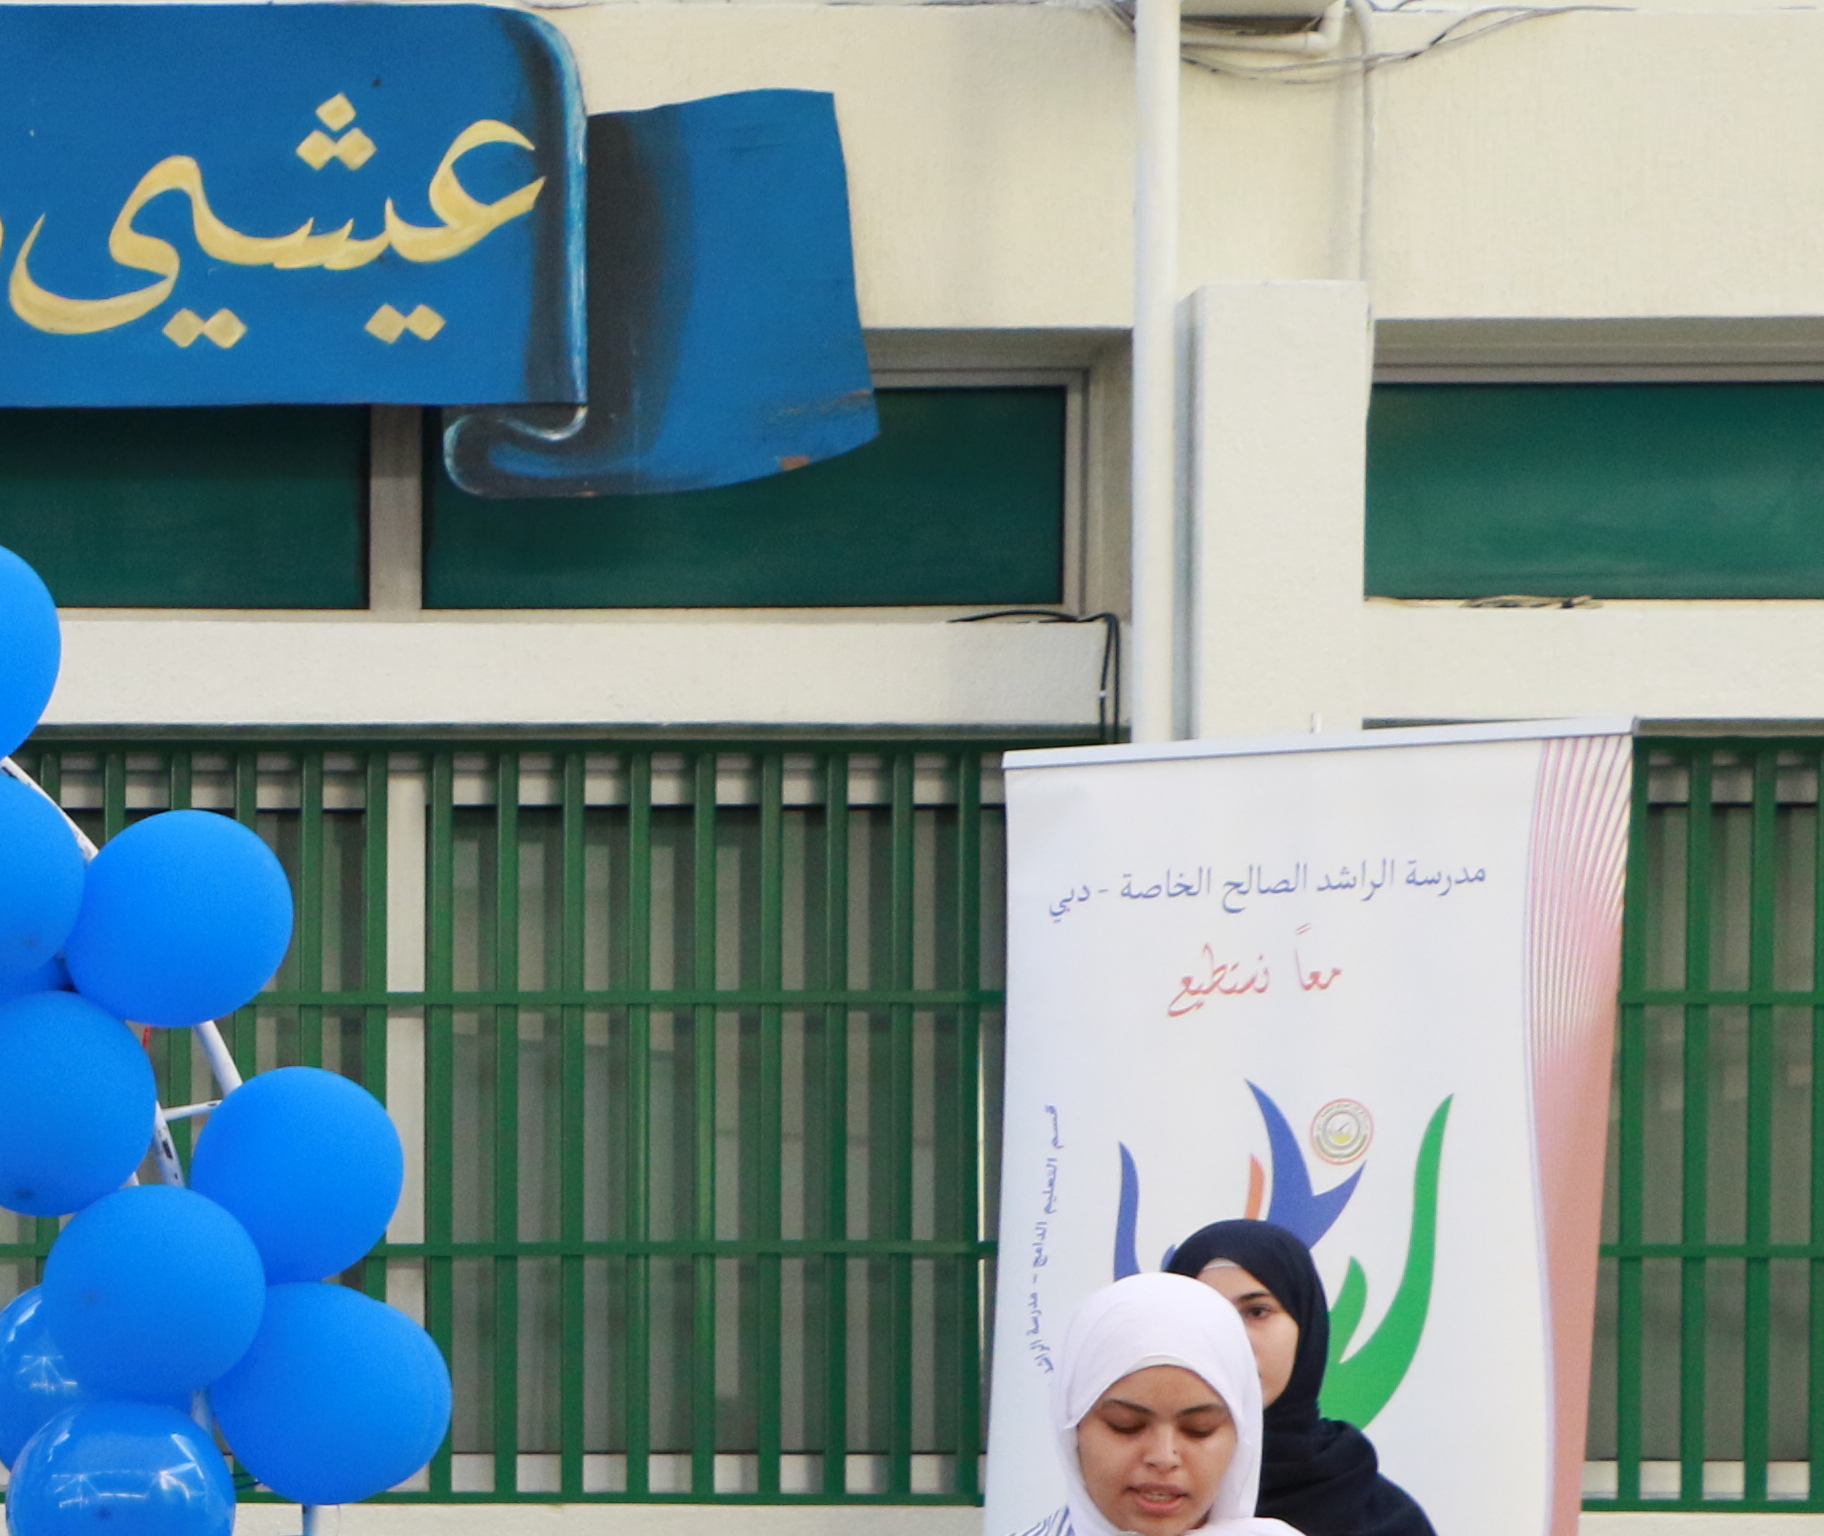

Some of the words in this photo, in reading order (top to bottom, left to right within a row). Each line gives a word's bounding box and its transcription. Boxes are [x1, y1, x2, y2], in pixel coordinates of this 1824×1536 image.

[8, 92, 547, 349] عيشي
[1120, 866, 1213, 900] الخاصة
[1221, 861, 1309, 914] الصالح
[1316, 857, 1396, 902] الراشد
[1404, 858, 1487, 897] مدرسة
[1048, 883, 1092, 924] دبي
[1166, 942, 1271, 1018] نستطيع
